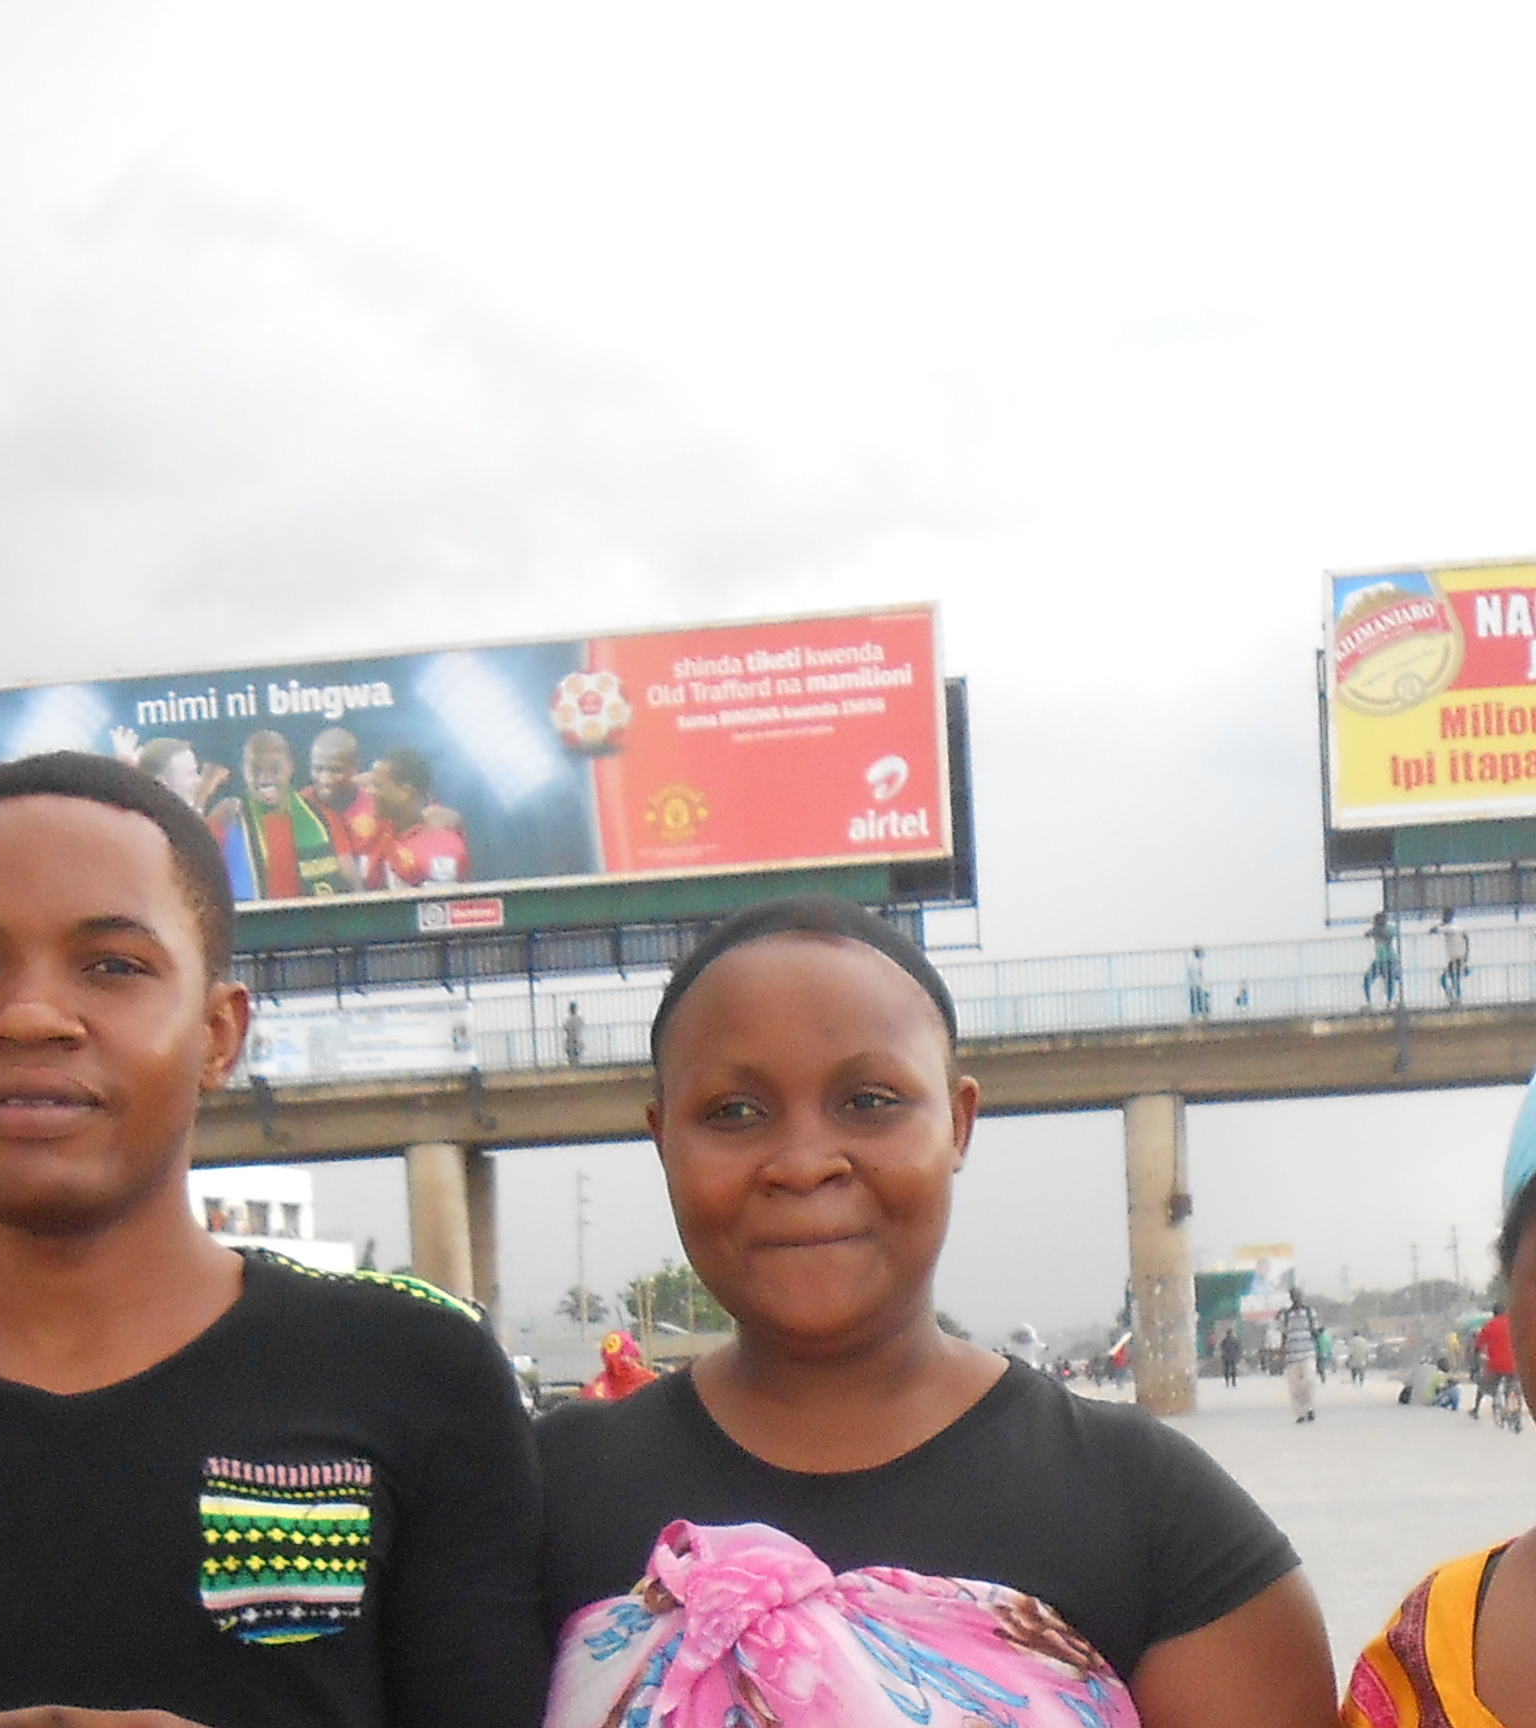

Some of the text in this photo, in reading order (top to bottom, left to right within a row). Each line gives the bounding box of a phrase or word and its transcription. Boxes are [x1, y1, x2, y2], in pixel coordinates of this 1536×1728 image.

[672, 641, 886, 679] shinda tiketi kwenda
[136, 679, 395, 725] mimi ni bingwa
[646, 663, 914, 706] Old Trafford na mamilioni
[1390, 751, 1437, 791] Ipi
[847, 807, 930, 843] airtel
